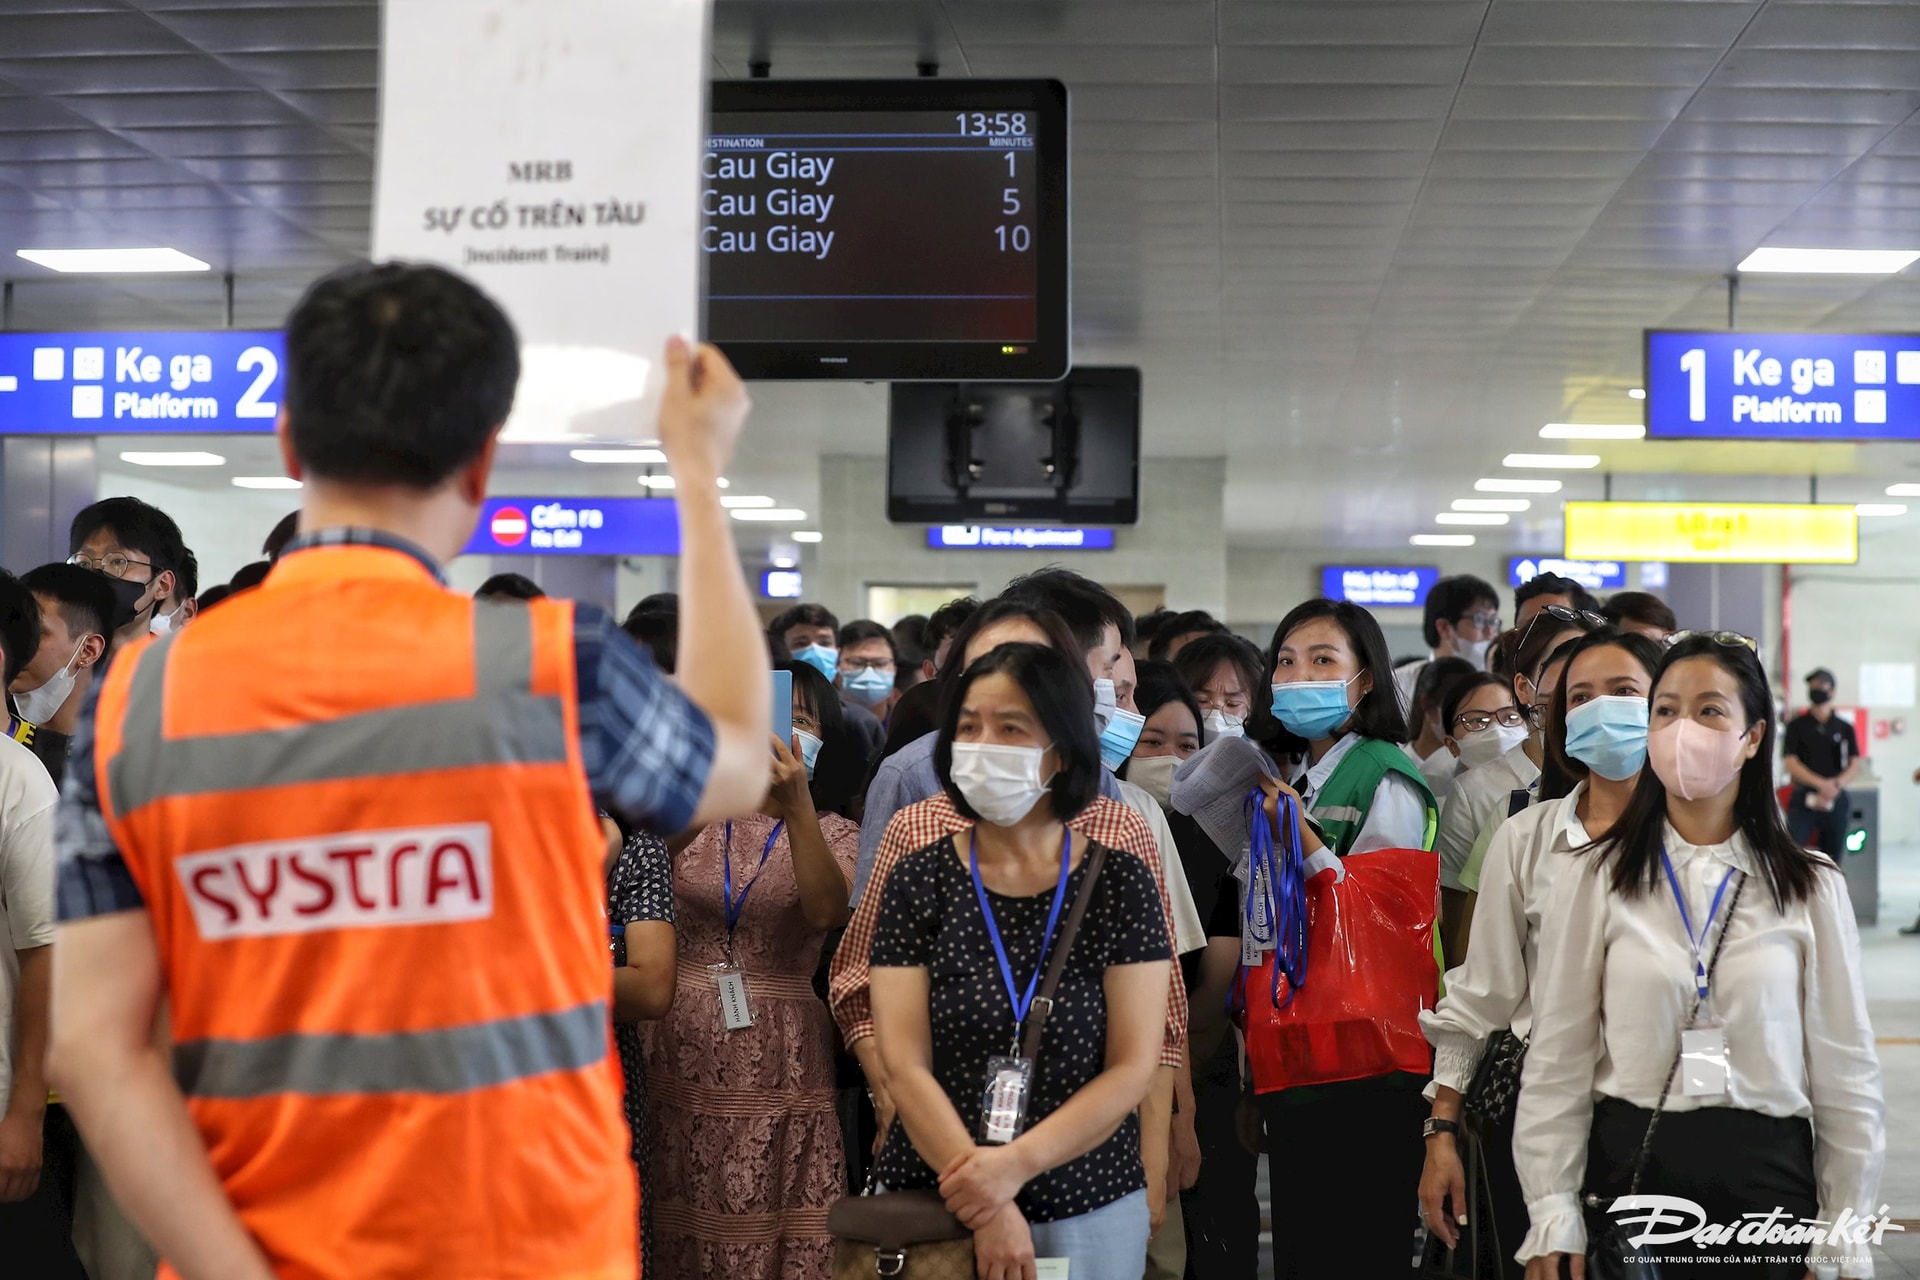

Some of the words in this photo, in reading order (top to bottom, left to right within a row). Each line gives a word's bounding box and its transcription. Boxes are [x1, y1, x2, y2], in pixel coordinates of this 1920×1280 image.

[956, 113, 1026, 136] 13:58
[989, 137, 1033, 147] MINUTES
[507, 161, 573, 183] MRB
[702, 153, 755, 178] Cau
[766, 152, 834, 185] Giay
[1003, 152, 1016, 177] 1
[424, 206, 464, 232] SỰ
[471, 199, 509, 230] CỐ
[518, 200, 584, 229] TRÊN
[593, 197, 645, 226] TÀU
[702, 190, 755, 215] Cau
[766, 188, 834, 222] Giay
[1002, 188, 1020, 215] 5
[702, 226, 755, 252] Cau
[766, 225, 834, 259] Giay
[994, 225, 1030, 251] 10
[116, 346, 162, 383] Ke
[170, 354, 212, 391] ga
[235, 346, 279, 418] 2
[1733, 349, 1782, 386] Ke
[1790, 357, 1835, 395] ga
[1680, 349, 1706, 421] 1
[114, 391, 218, 419] Platform
[1732, 395, 1842, 423] Platform
